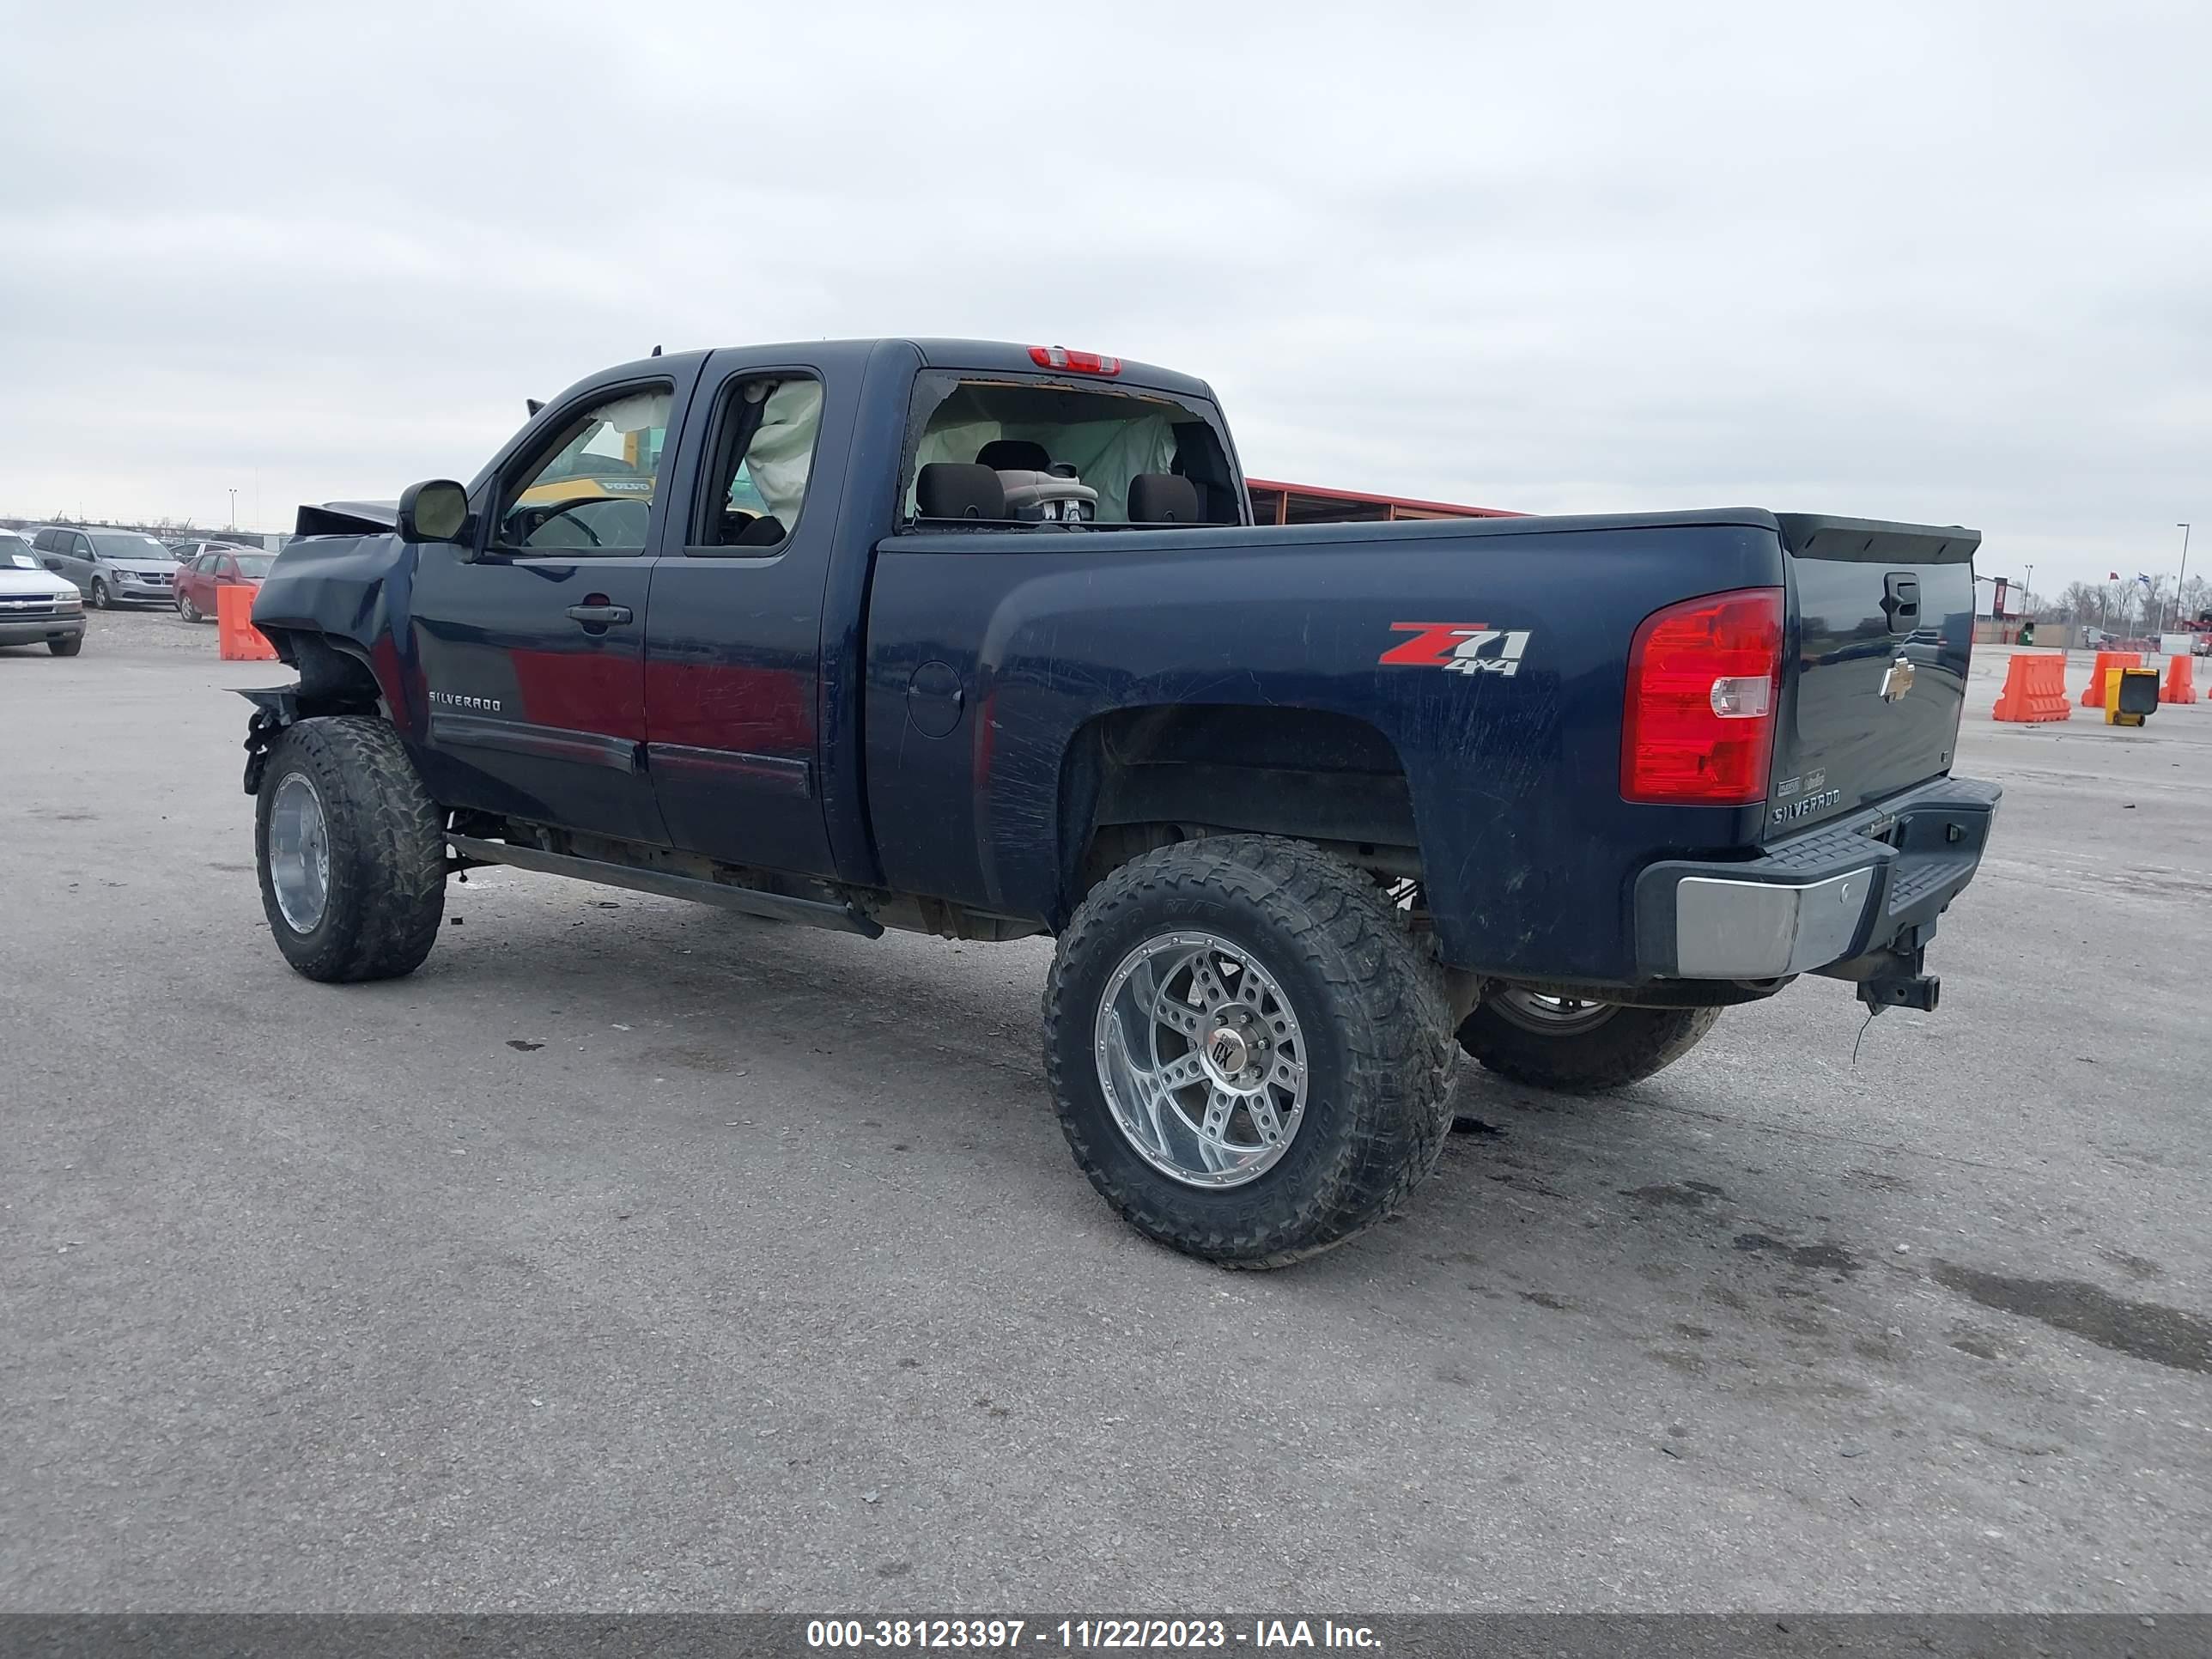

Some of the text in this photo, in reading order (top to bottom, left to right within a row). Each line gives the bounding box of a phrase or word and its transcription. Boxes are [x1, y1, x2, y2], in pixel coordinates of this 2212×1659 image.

[1378, 621, 1533, 666] Z71
[428, 691, 501, 711] SILVERADO
[1772, 789, 1841, 824] SILVERADO
